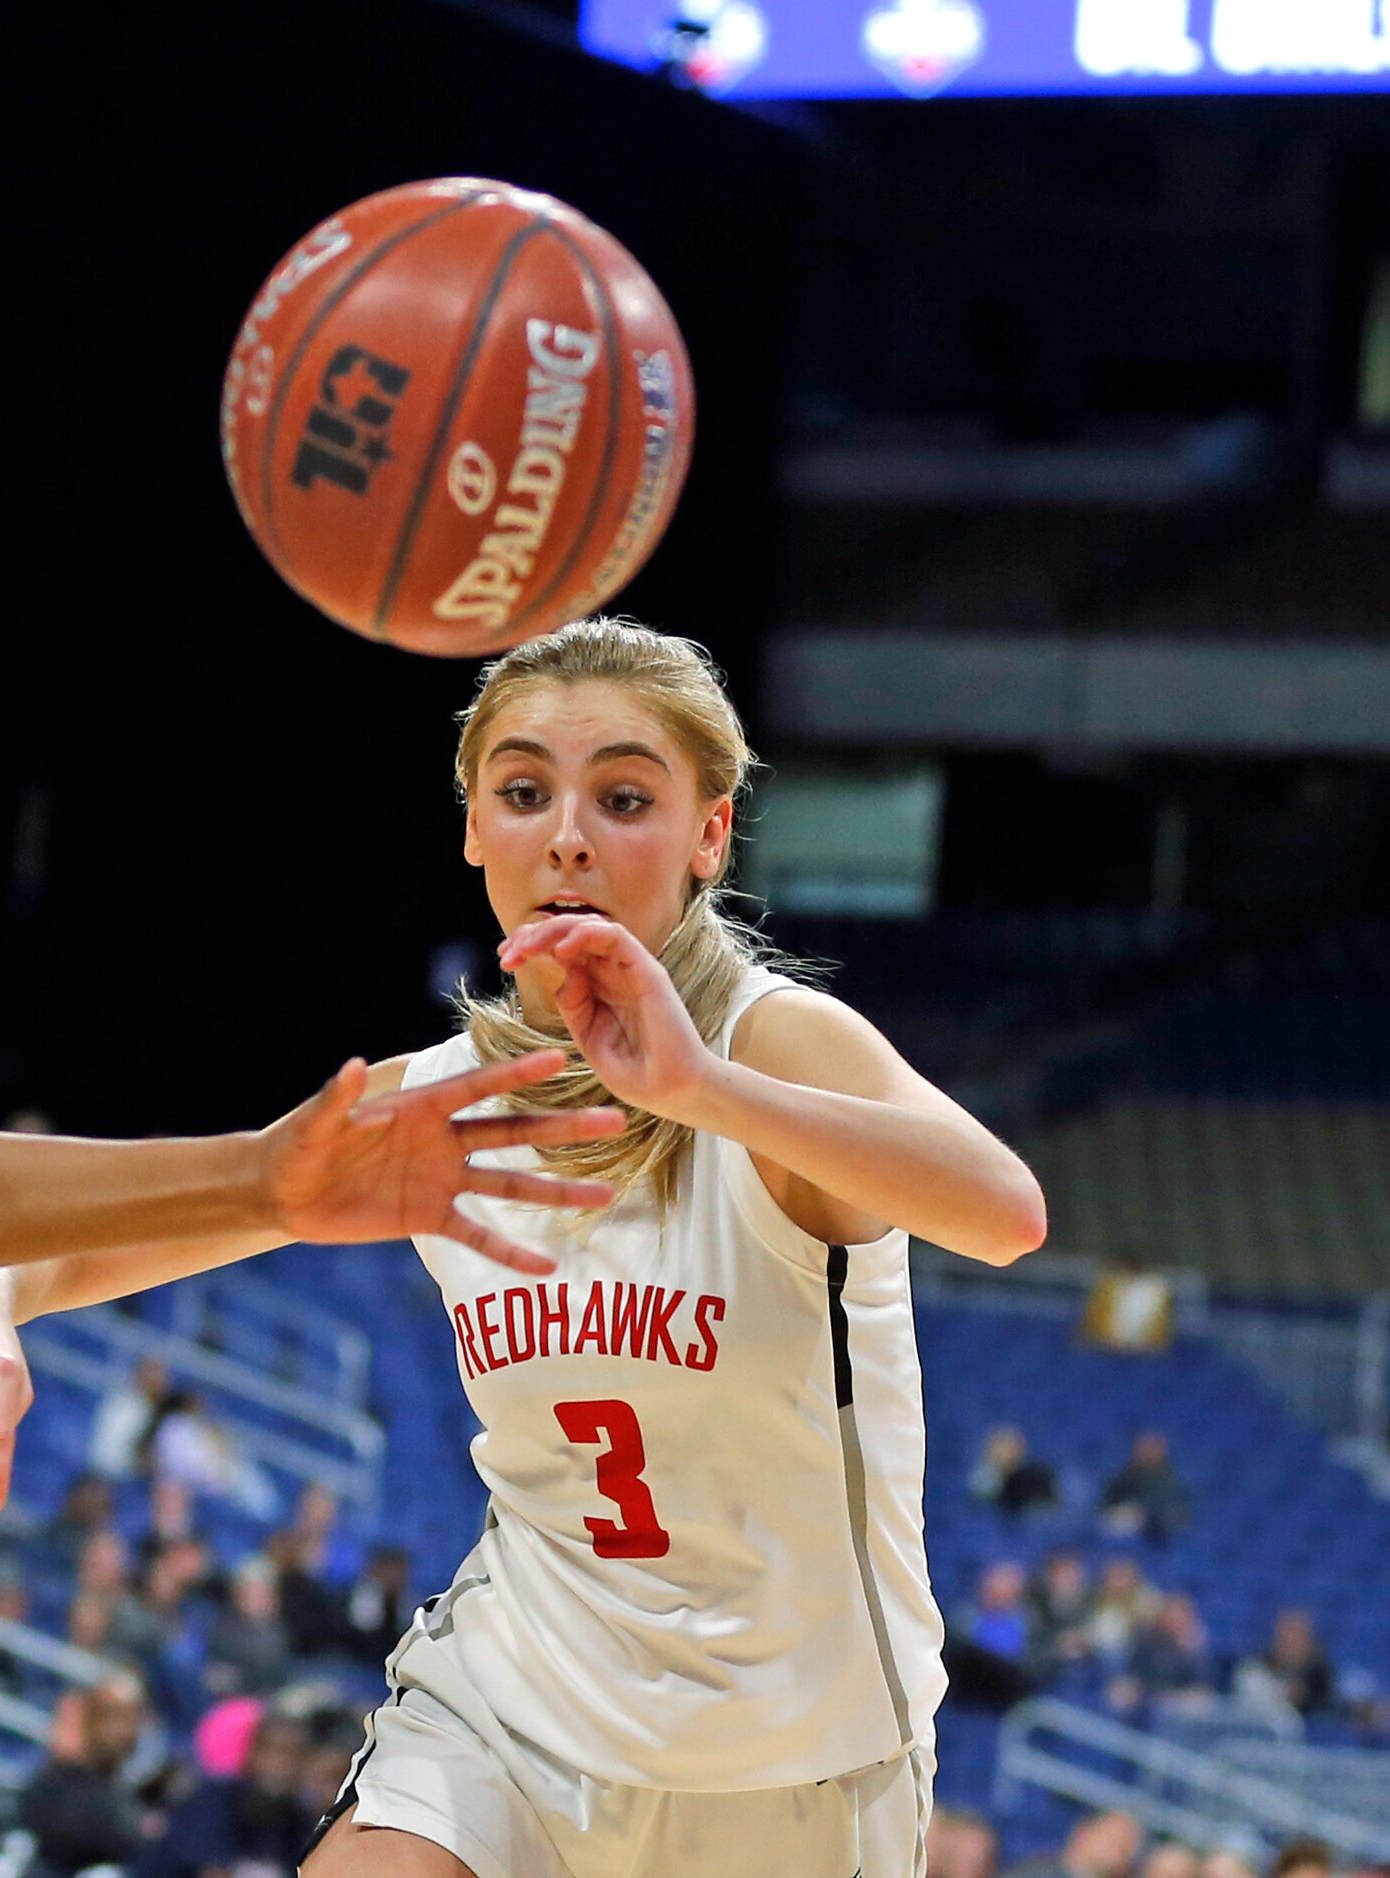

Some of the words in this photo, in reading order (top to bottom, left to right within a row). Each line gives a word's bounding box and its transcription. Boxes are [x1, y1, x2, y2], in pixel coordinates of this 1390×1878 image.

[432, 317, 600, 628] SPALDING
[453, 1280, 727, 1380] REDHAWKS
[553, 1399, 670, 1560] 3
